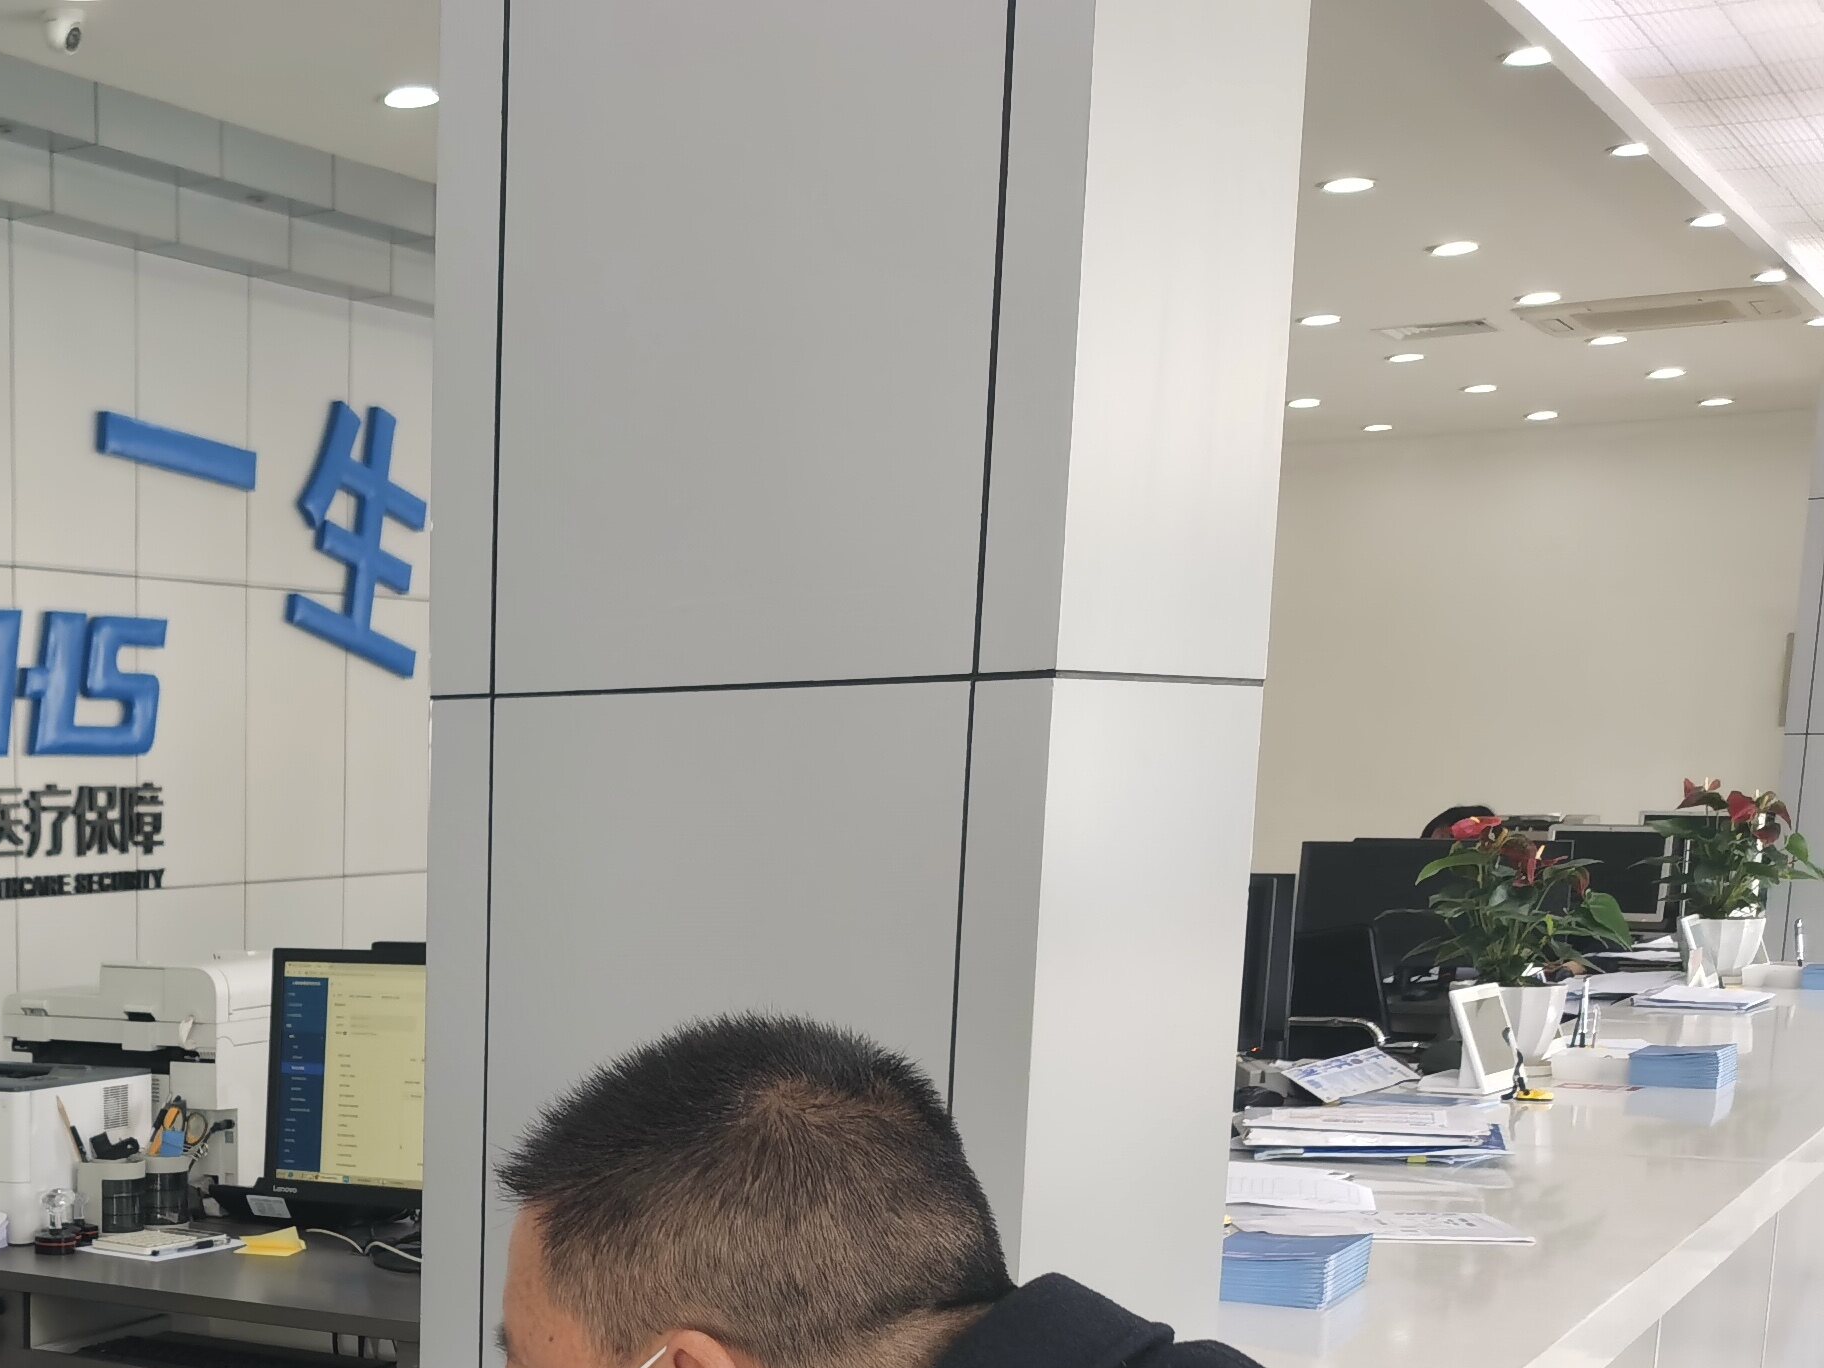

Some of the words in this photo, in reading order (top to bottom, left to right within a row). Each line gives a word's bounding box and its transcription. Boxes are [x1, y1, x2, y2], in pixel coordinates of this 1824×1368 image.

[95, 399, 428, 678] 一生
[74, 867, 165, 893] SECURITY
[272, 1184, 298, 1194] Lenovo
